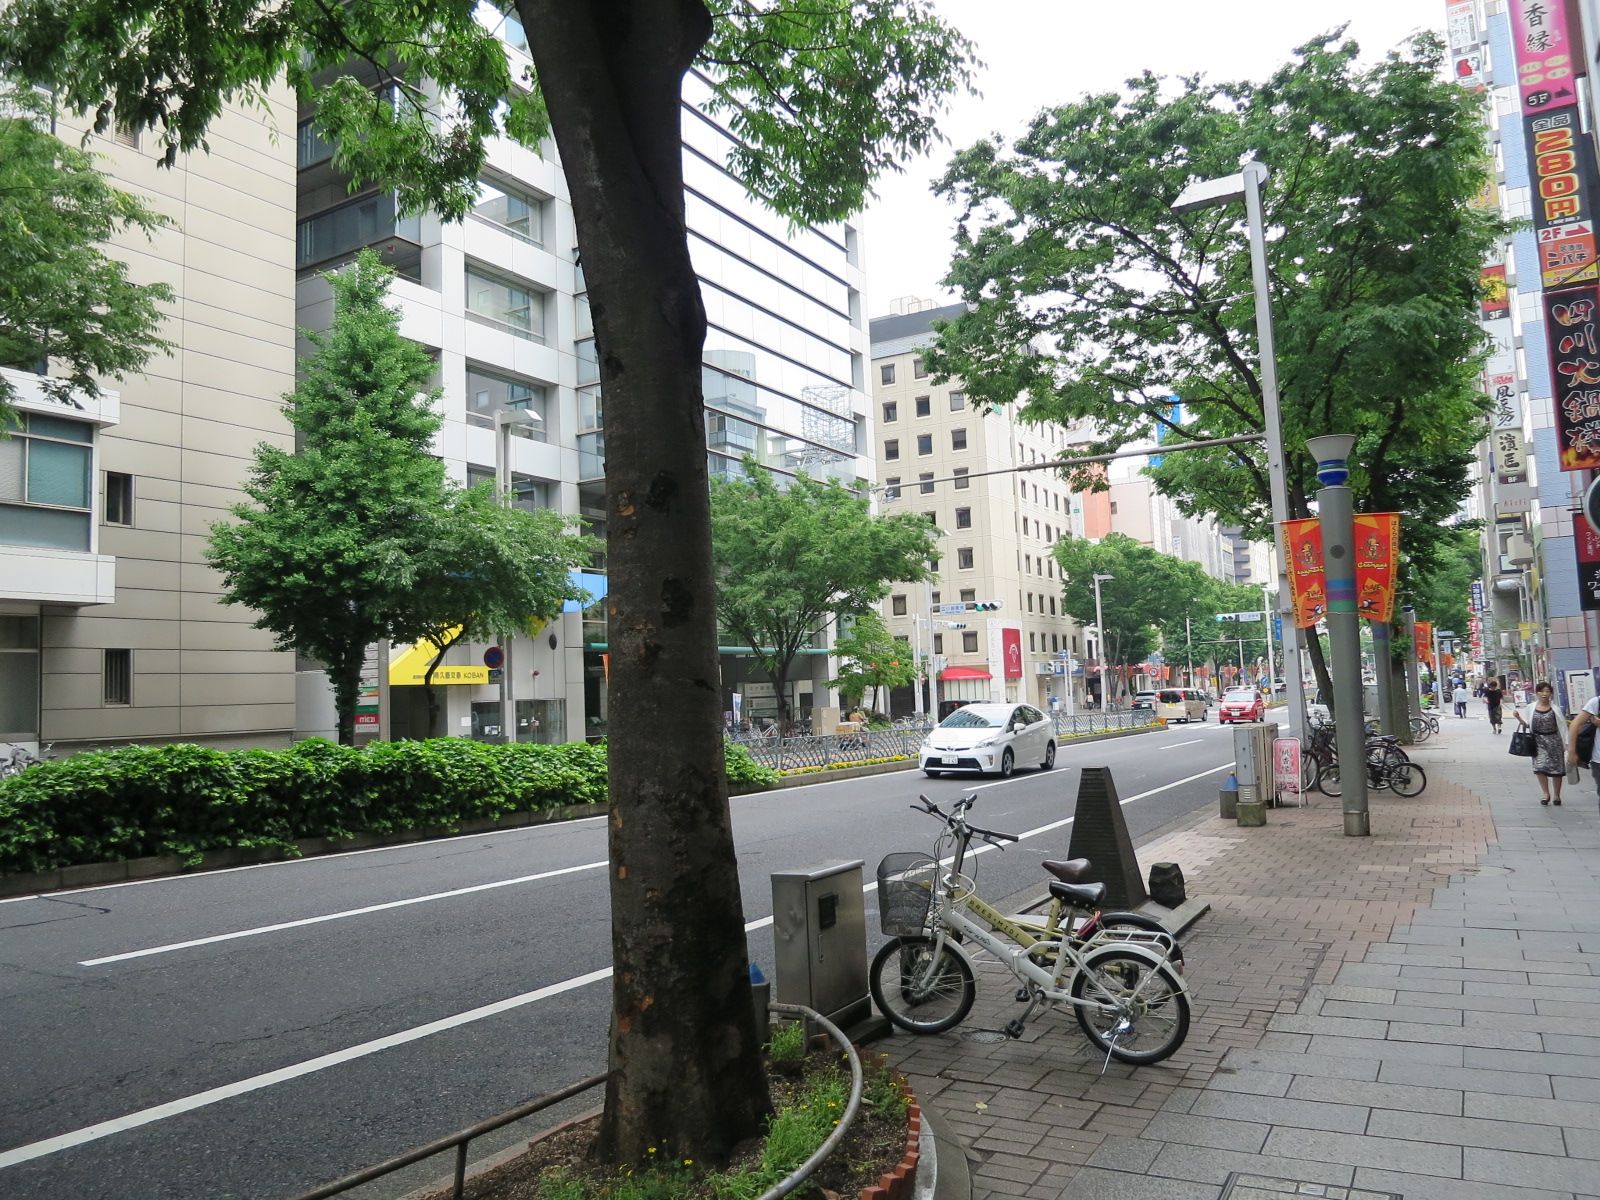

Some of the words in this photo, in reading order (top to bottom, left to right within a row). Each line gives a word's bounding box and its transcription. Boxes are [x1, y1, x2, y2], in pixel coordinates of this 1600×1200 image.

[1523, 0, 1554, 52] 香縁
[1528, 92, 1549, 106] 5F
[1532, 113, 1571, 132] 全品
[1534, 127, 1581, 220] 280円
[1541, 228, 1562, 241] 2F
[1488, 309, 1503, 320] 3F
[464, 671, 485, 680] KOBAN
